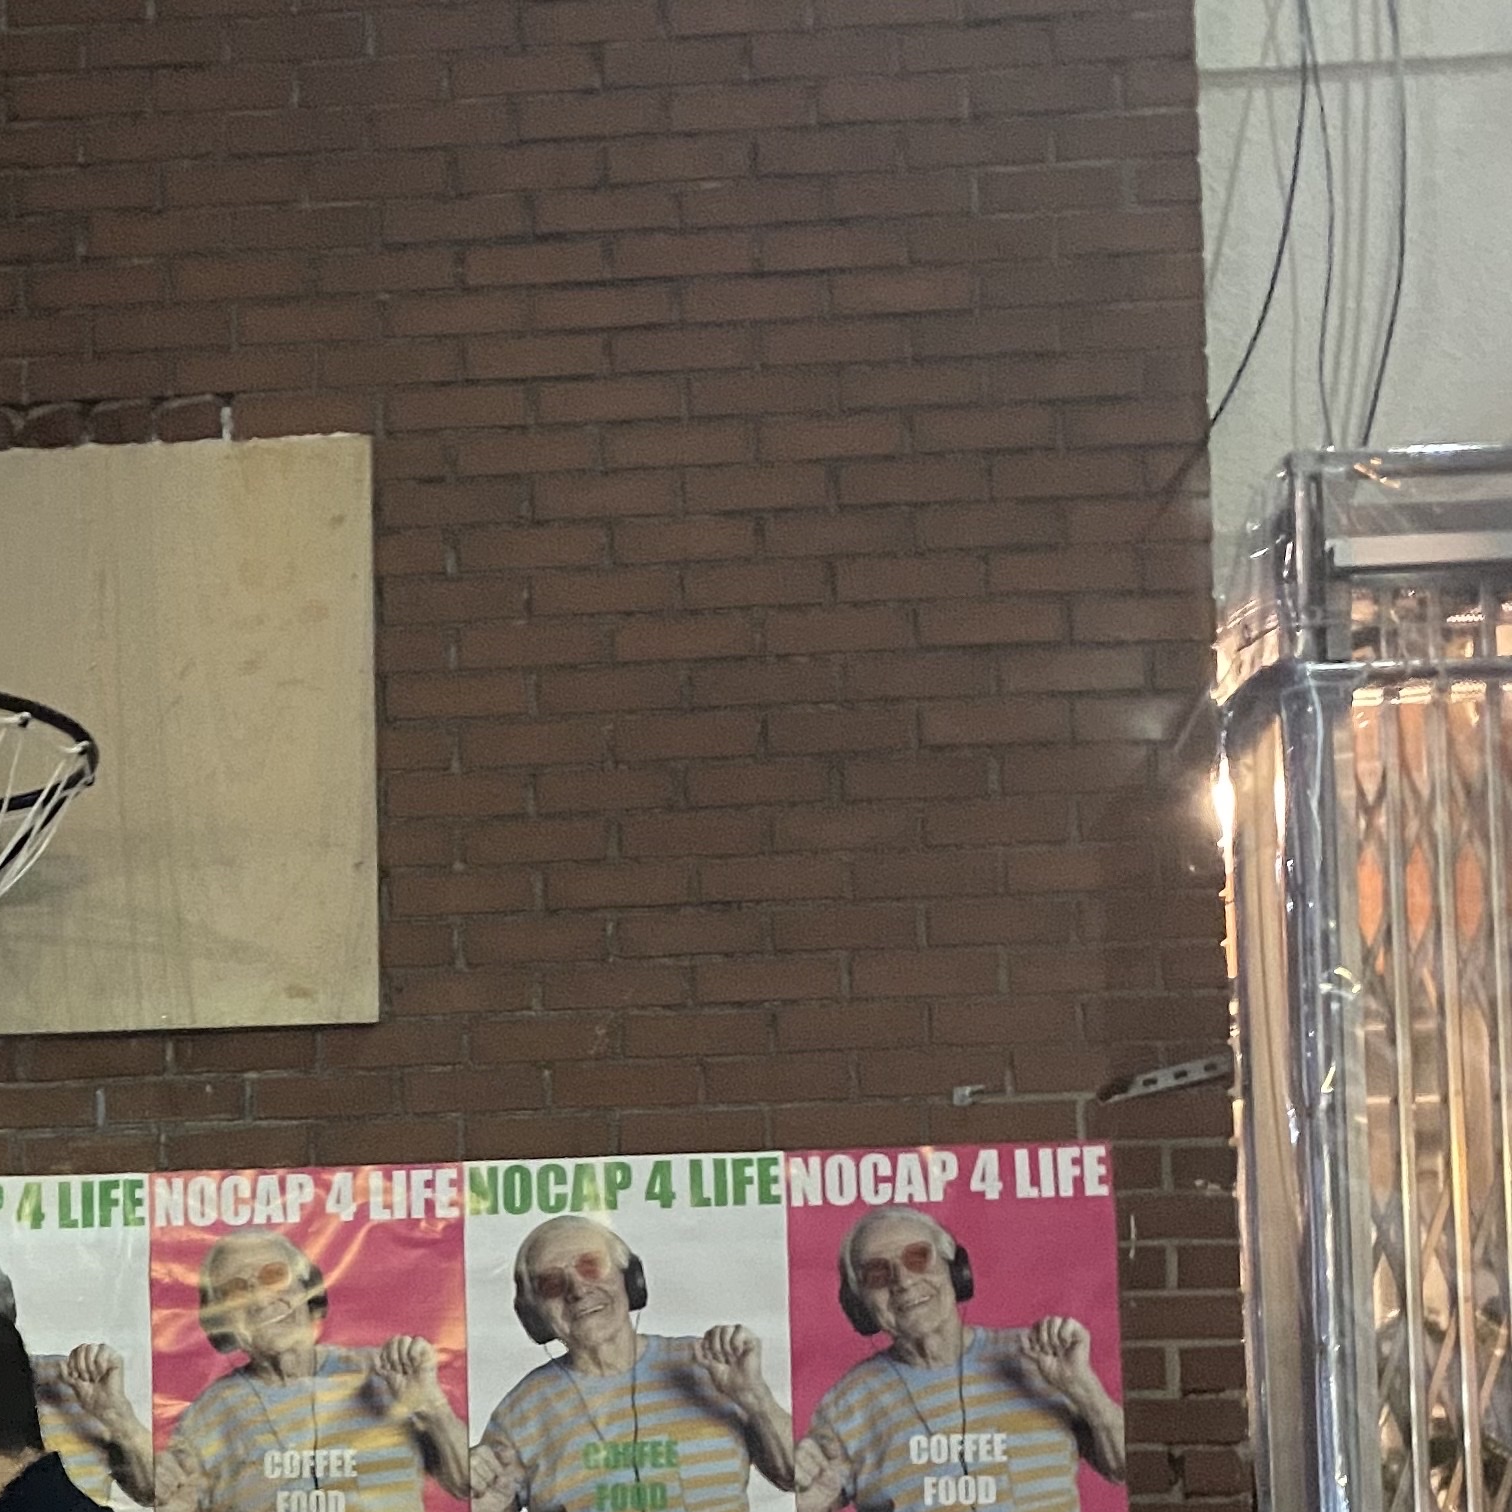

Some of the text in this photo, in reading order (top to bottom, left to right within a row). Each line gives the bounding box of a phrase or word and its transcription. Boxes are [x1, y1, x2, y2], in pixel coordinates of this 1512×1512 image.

[469, 1157, 781, 1216] NOCAP 4 LIFE
[791, 1146, 1109, 1207] NOCAP 4 LIFE
[16, 1183, 45, 1228] 4
[58, 1179, 145, 1228] LIFE
[156, 1169, 458, 1227] NOCAP 4 LIFE
[264, 1449, 357, 1479] COFFEE
[910, 1434, 1007, 1465] COFFEE
[595, 1482, 667, 1511] FOOD
[924, 1475, 996, 1505] FOOD
